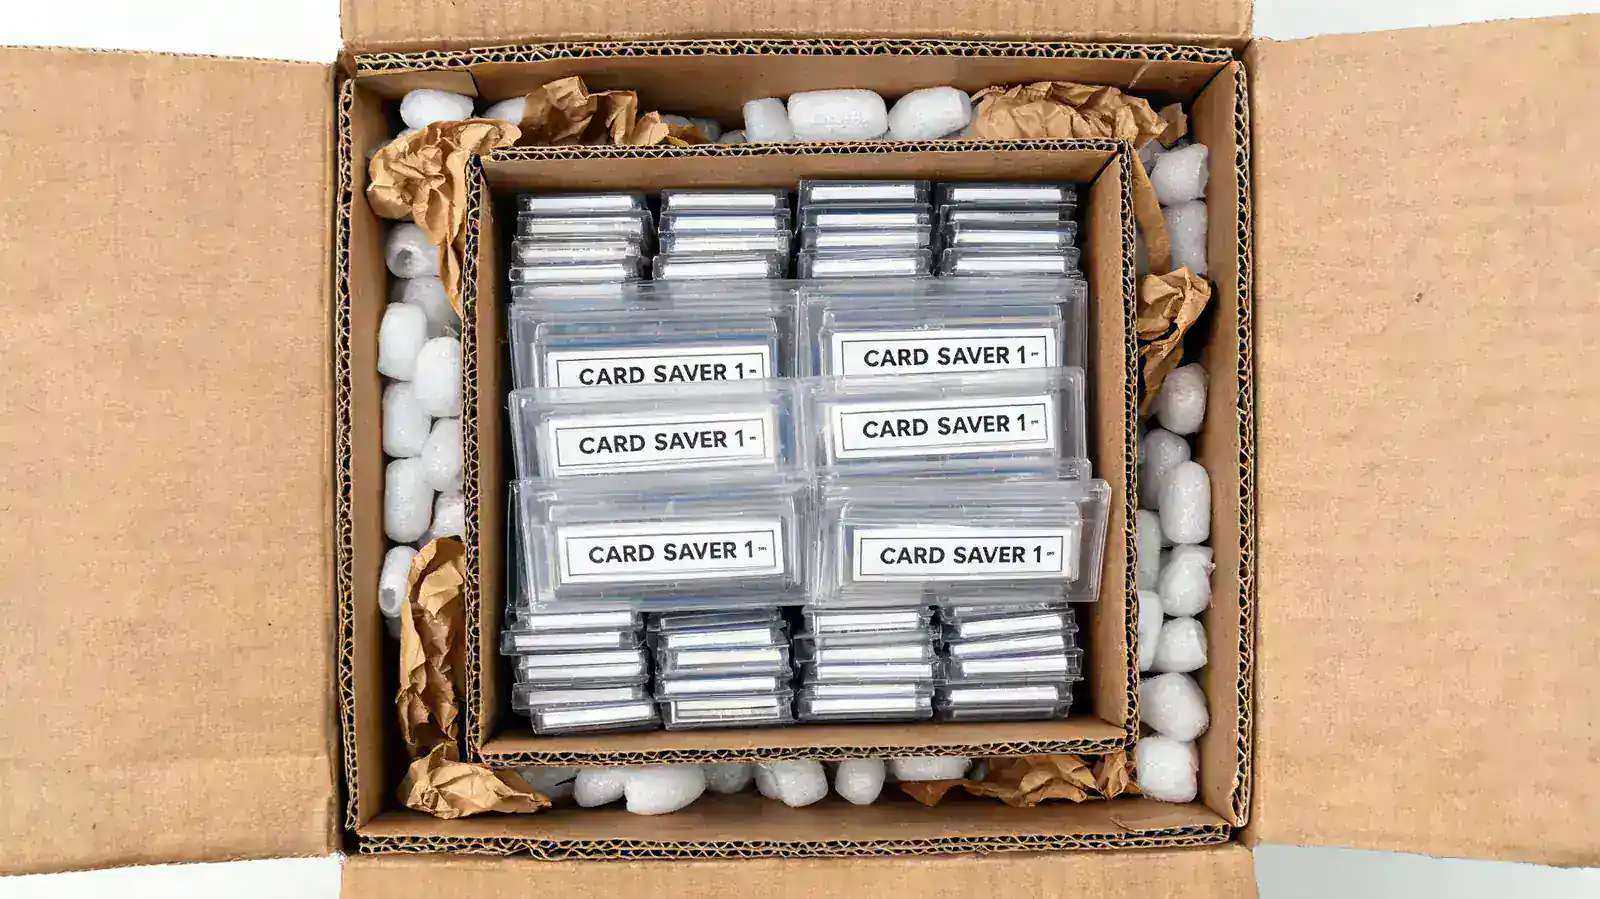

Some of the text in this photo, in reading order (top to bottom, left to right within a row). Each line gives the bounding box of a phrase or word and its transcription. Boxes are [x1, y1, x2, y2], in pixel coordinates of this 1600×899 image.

[863, 348, 929, 368] CARD
[937, 346, 1010, 366] SAVER
[578, 366, 645, 386] CARD
[653, 363, 729, 383] SAVER
[862, 418, 929, 439] CARD
[937, 414, 1010, 436] SAVER
[578, 434, 646, 455] CARD
[654, 430, 728, 451] SAVER
[588, 544, 655, 564] CARD
[663, 541, 737, 562] SAVER
[879, 546, 946, 565] CARD
[953, 546, 1026, 564] SAVER
